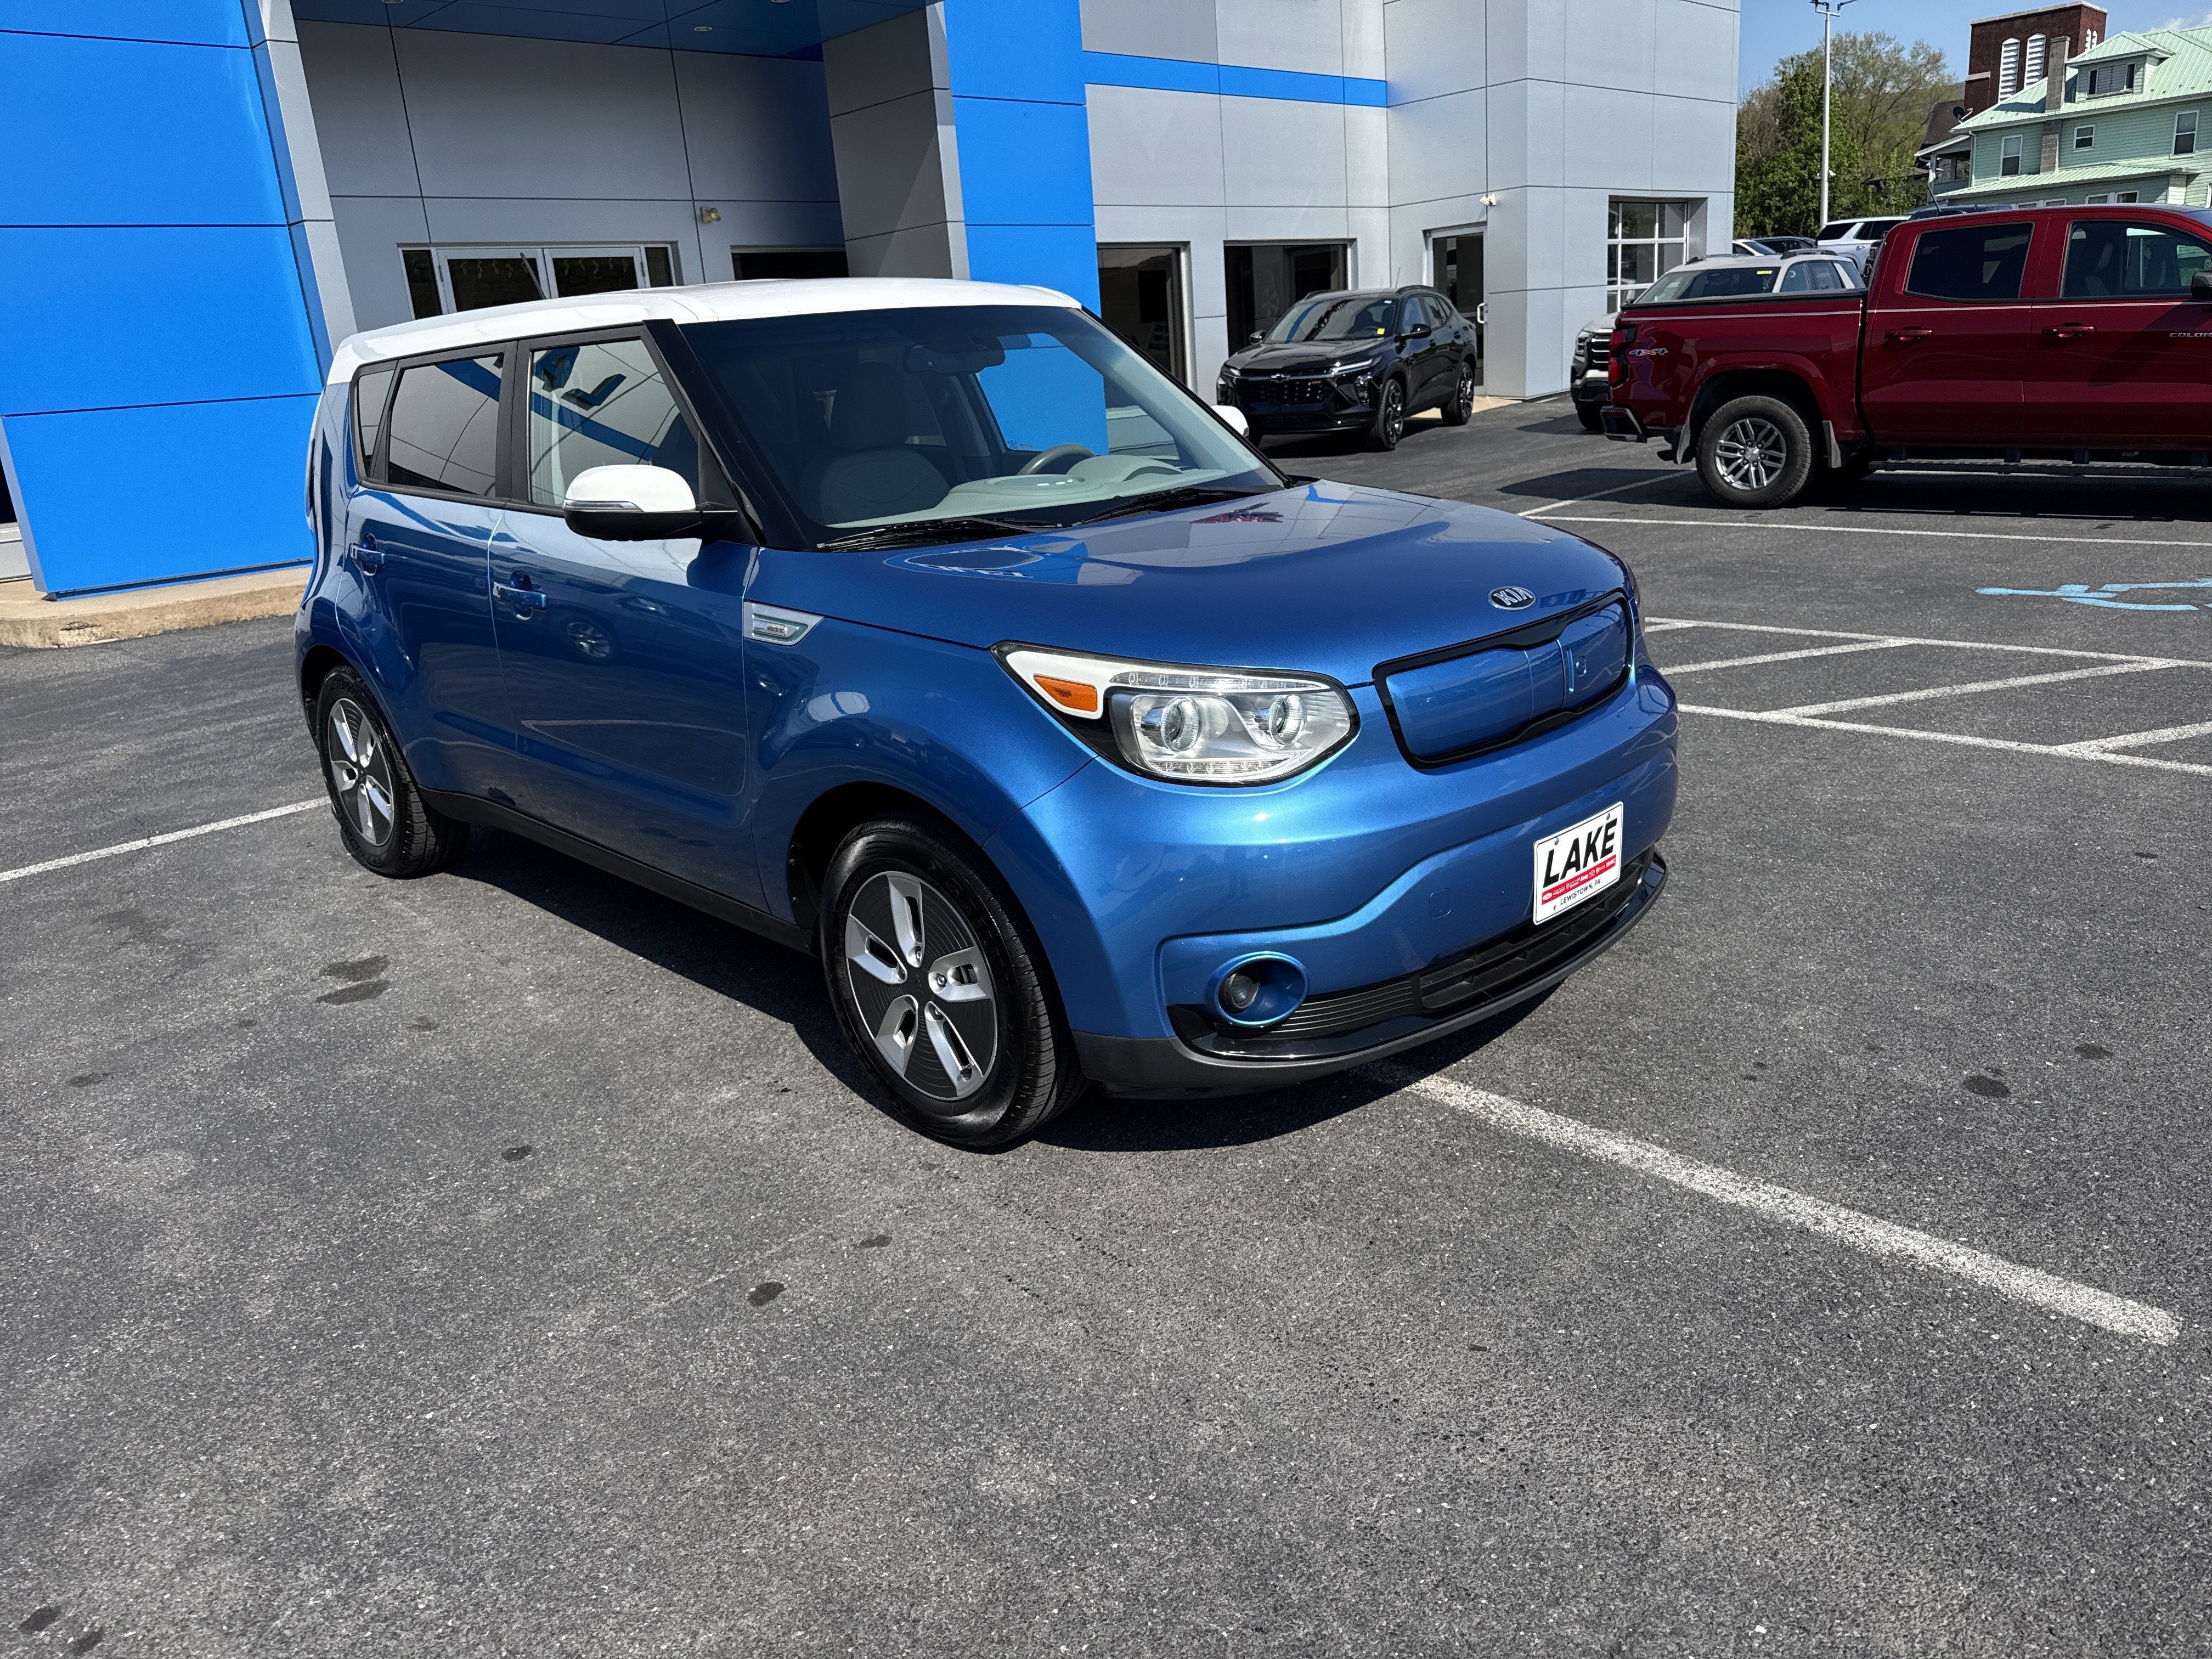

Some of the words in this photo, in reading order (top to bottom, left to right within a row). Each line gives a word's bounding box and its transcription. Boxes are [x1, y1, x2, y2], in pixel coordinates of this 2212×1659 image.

[1493, 587, 1533, 606] KIA
[767, 625, 785, 634] electric
[1542, 817, 1618, 889] LAKE
[1560, 883, 1593, 905] LEWISTOWN,
[1594, 878, 1601, 887] PA
